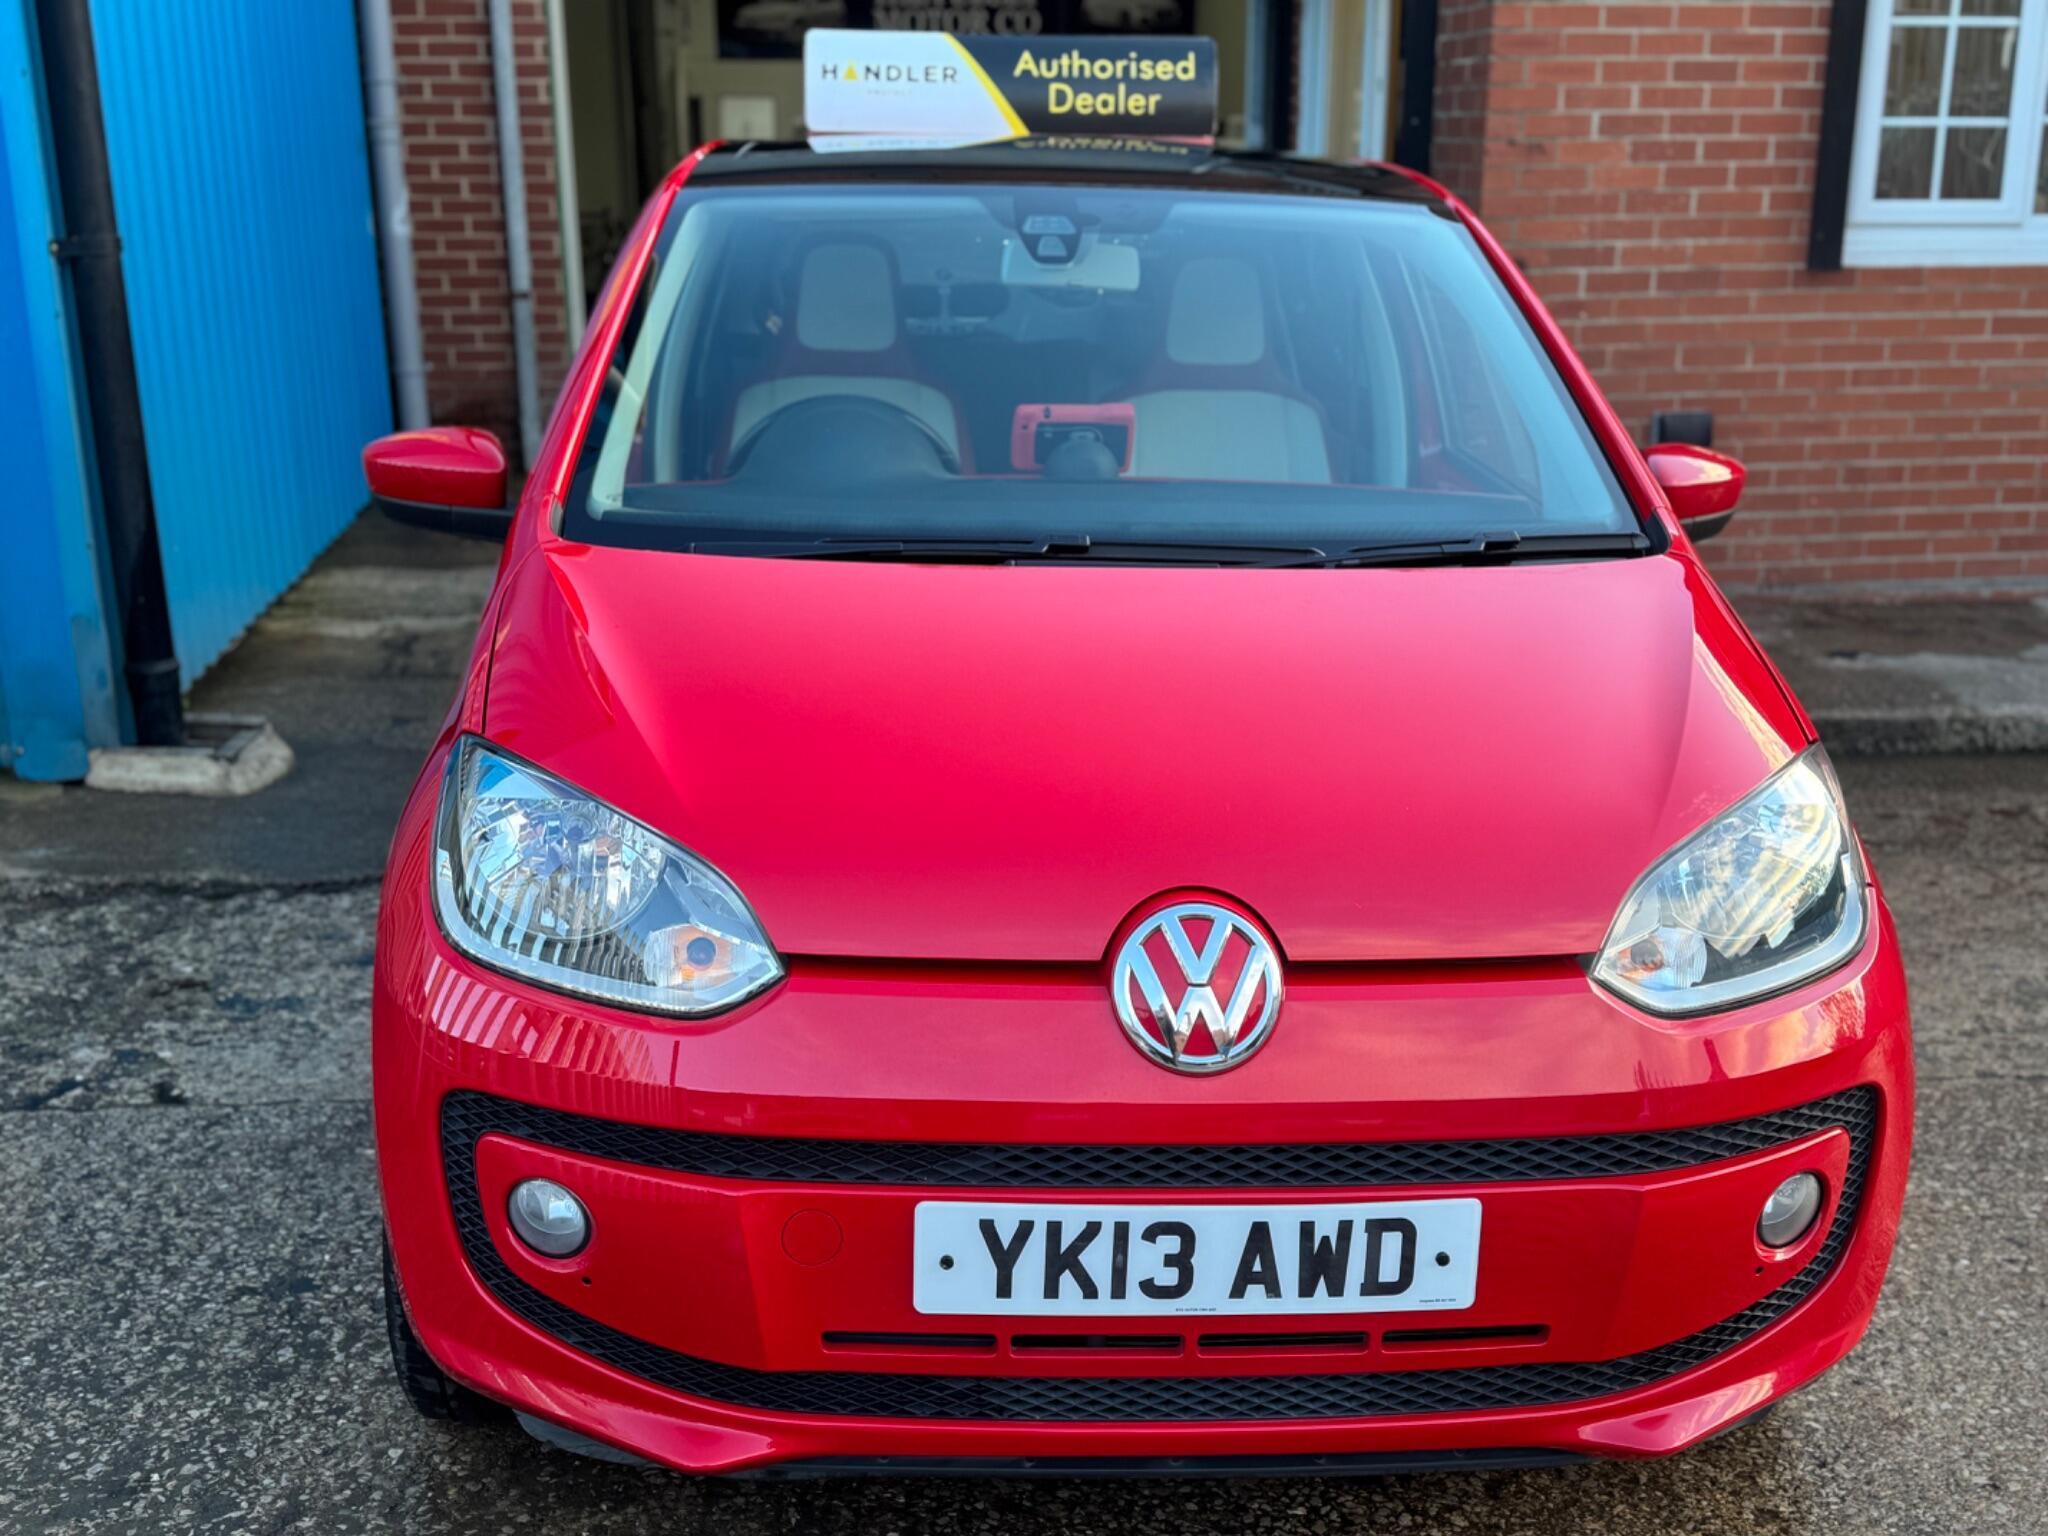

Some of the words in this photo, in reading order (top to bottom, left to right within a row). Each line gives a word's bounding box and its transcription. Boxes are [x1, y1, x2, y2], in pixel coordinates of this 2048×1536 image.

[994, 8, 1043, 34] CO
[1013, 49, 1196, 81] Authorised
[1048, 82, 1162, 116] Dealer
[1113, 903, 1284, 1074] VW
[978, 1218, 1197, 1301] YK13
[1228, 1217, 1418, 1299] AWD
